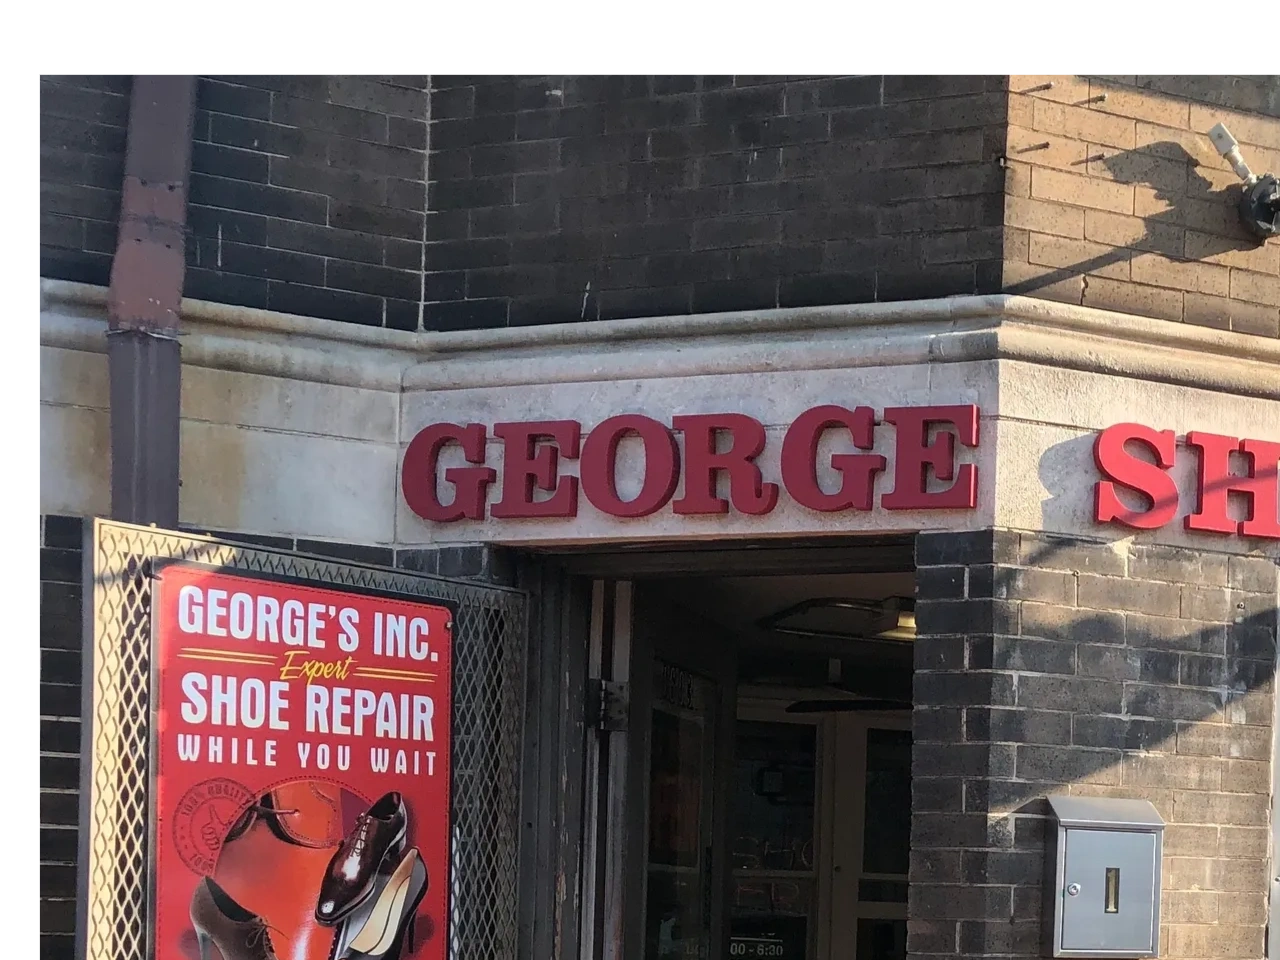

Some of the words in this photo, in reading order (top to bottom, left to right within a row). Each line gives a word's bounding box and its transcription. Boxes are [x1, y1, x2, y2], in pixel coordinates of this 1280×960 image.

[401, 403, 980, 523] GEORGE
[178, 585, 359, 652] GEORGE'S
[374, 611, 438, 662] INC.
[280, 650, 354, 687] Expert
[180, 672, 290, 730] SHOE
[306, 684, 435, 742] REPAIR
[177, 734, 278, 767] WHILE
[297, 742, 352, 771] YOU
[370, 747, 437, 776] WAIT
